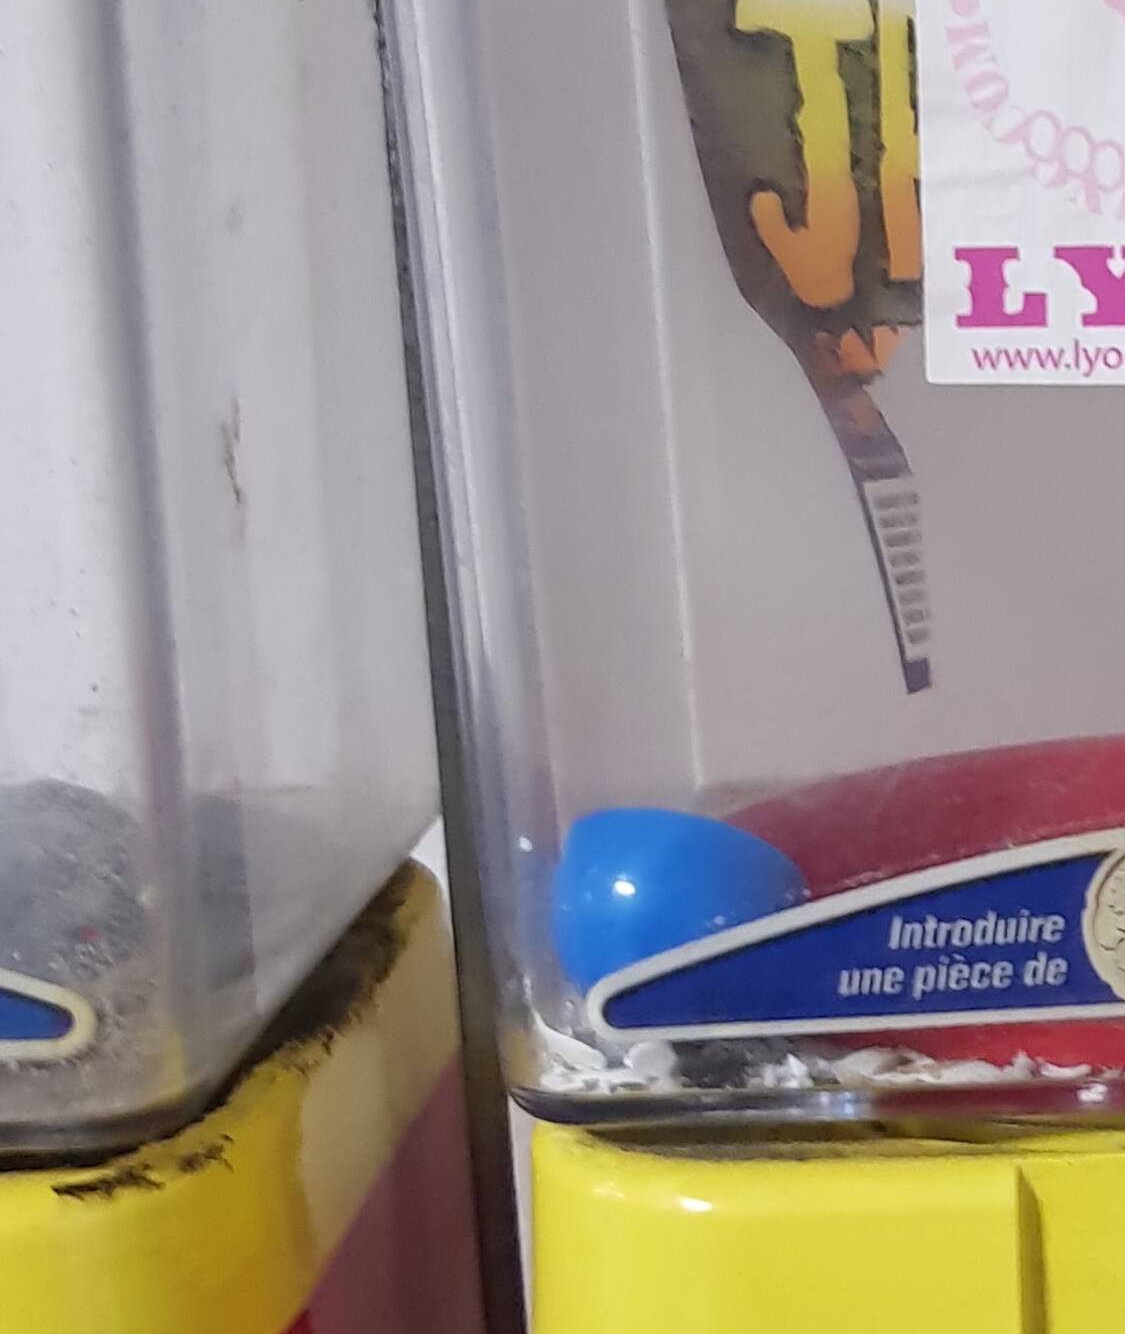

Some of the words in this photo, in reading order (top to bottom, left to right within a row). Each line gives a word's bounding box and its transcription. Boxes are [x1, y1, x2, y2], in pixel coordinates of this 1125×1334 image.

[887, 907, 1066, 951] Introduire
[837, 965, 905, 997] une
[911, 953, 1014, 1001] pièce
[1023, 951, 1068, 987] de
